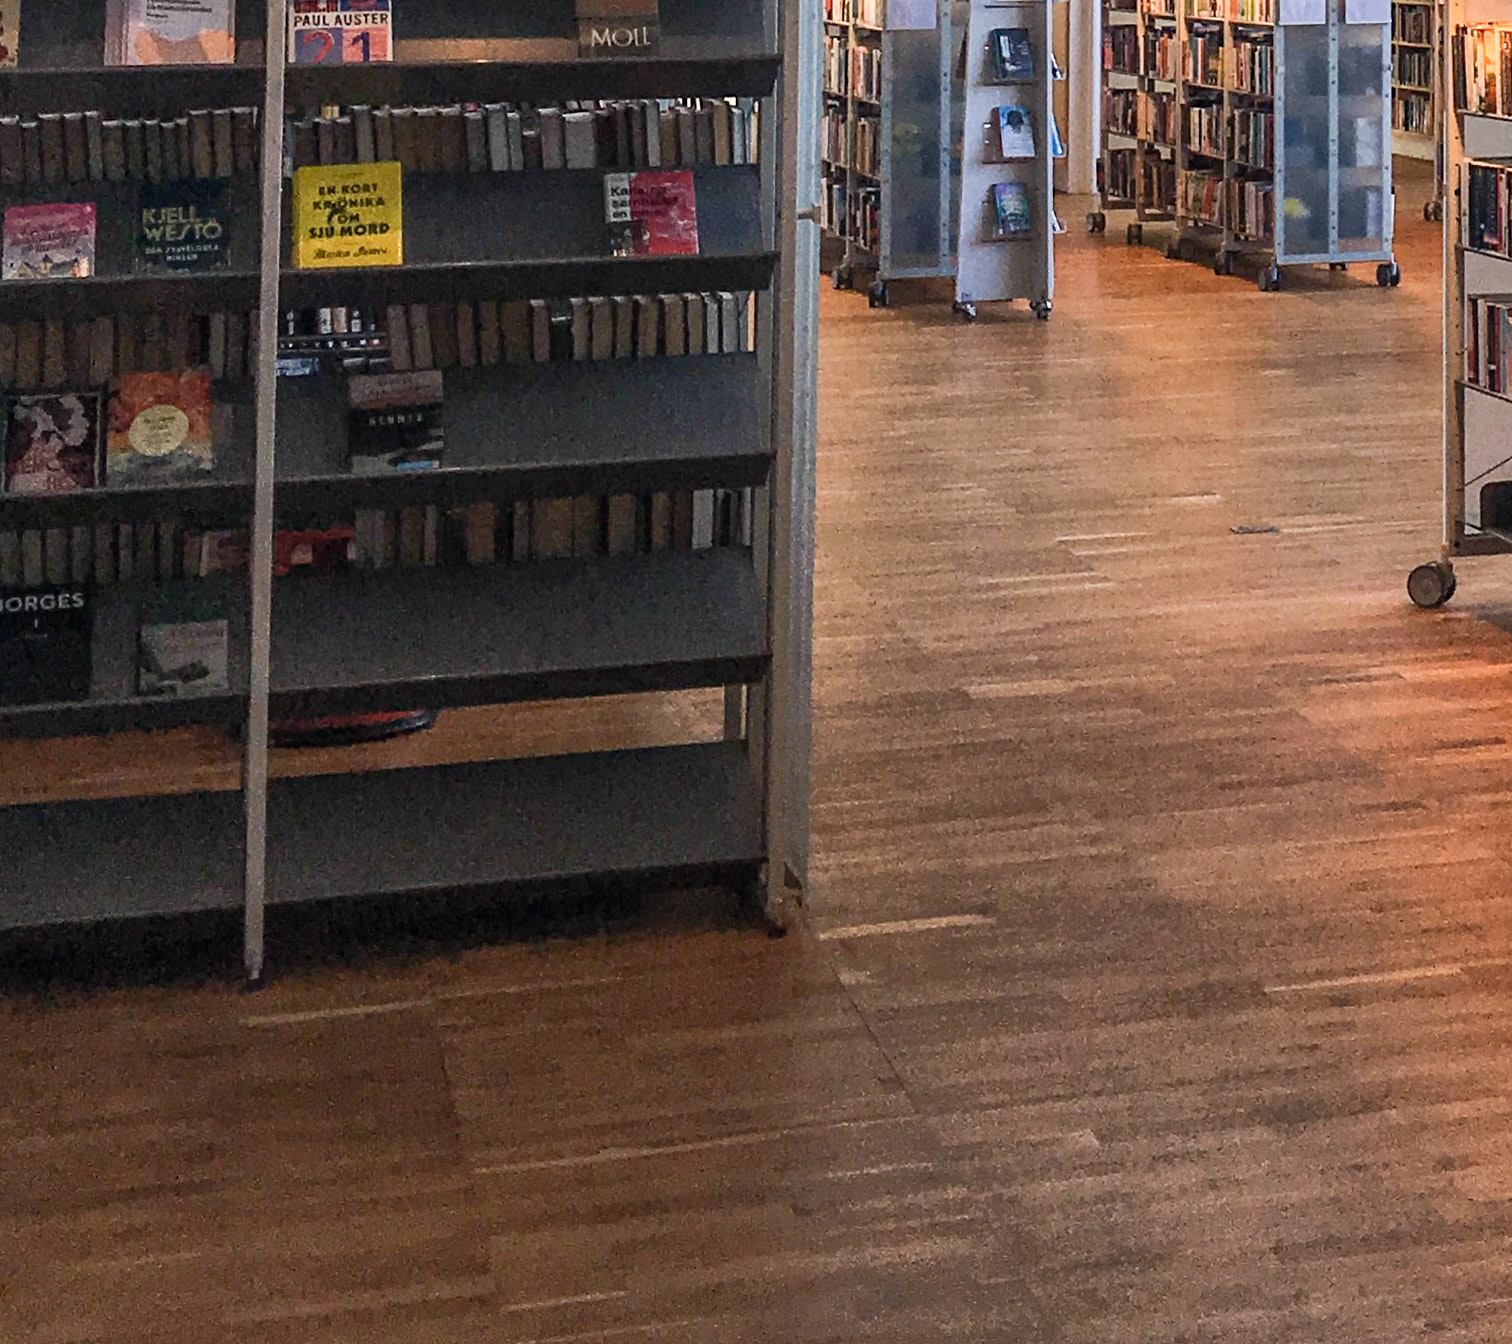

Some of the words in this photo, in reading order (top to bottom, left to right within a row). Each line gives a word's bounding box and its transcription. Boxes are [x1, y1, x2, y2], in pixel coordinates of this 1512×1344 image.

[293, 14, 330, 28] PAUL
[334, 13, 389, 26] AUSTER
[590, 25, 652, 47] MOLL
[302, 30, 335, 62] 2
[350, 31, 371, 62] 1
[318, 185, 336, 196] EN
[341, 183, 379, 195] KORT
[312, 196, 386, 211] KRÖNIKA
[142, 206, 202, 224] KJELL
[337, 213, 360, 225] OM
[142, 217, 223, 242] WESTÖ
[308, 226, 335, 239] SJU
[340, 222, 390, 238] MORD
